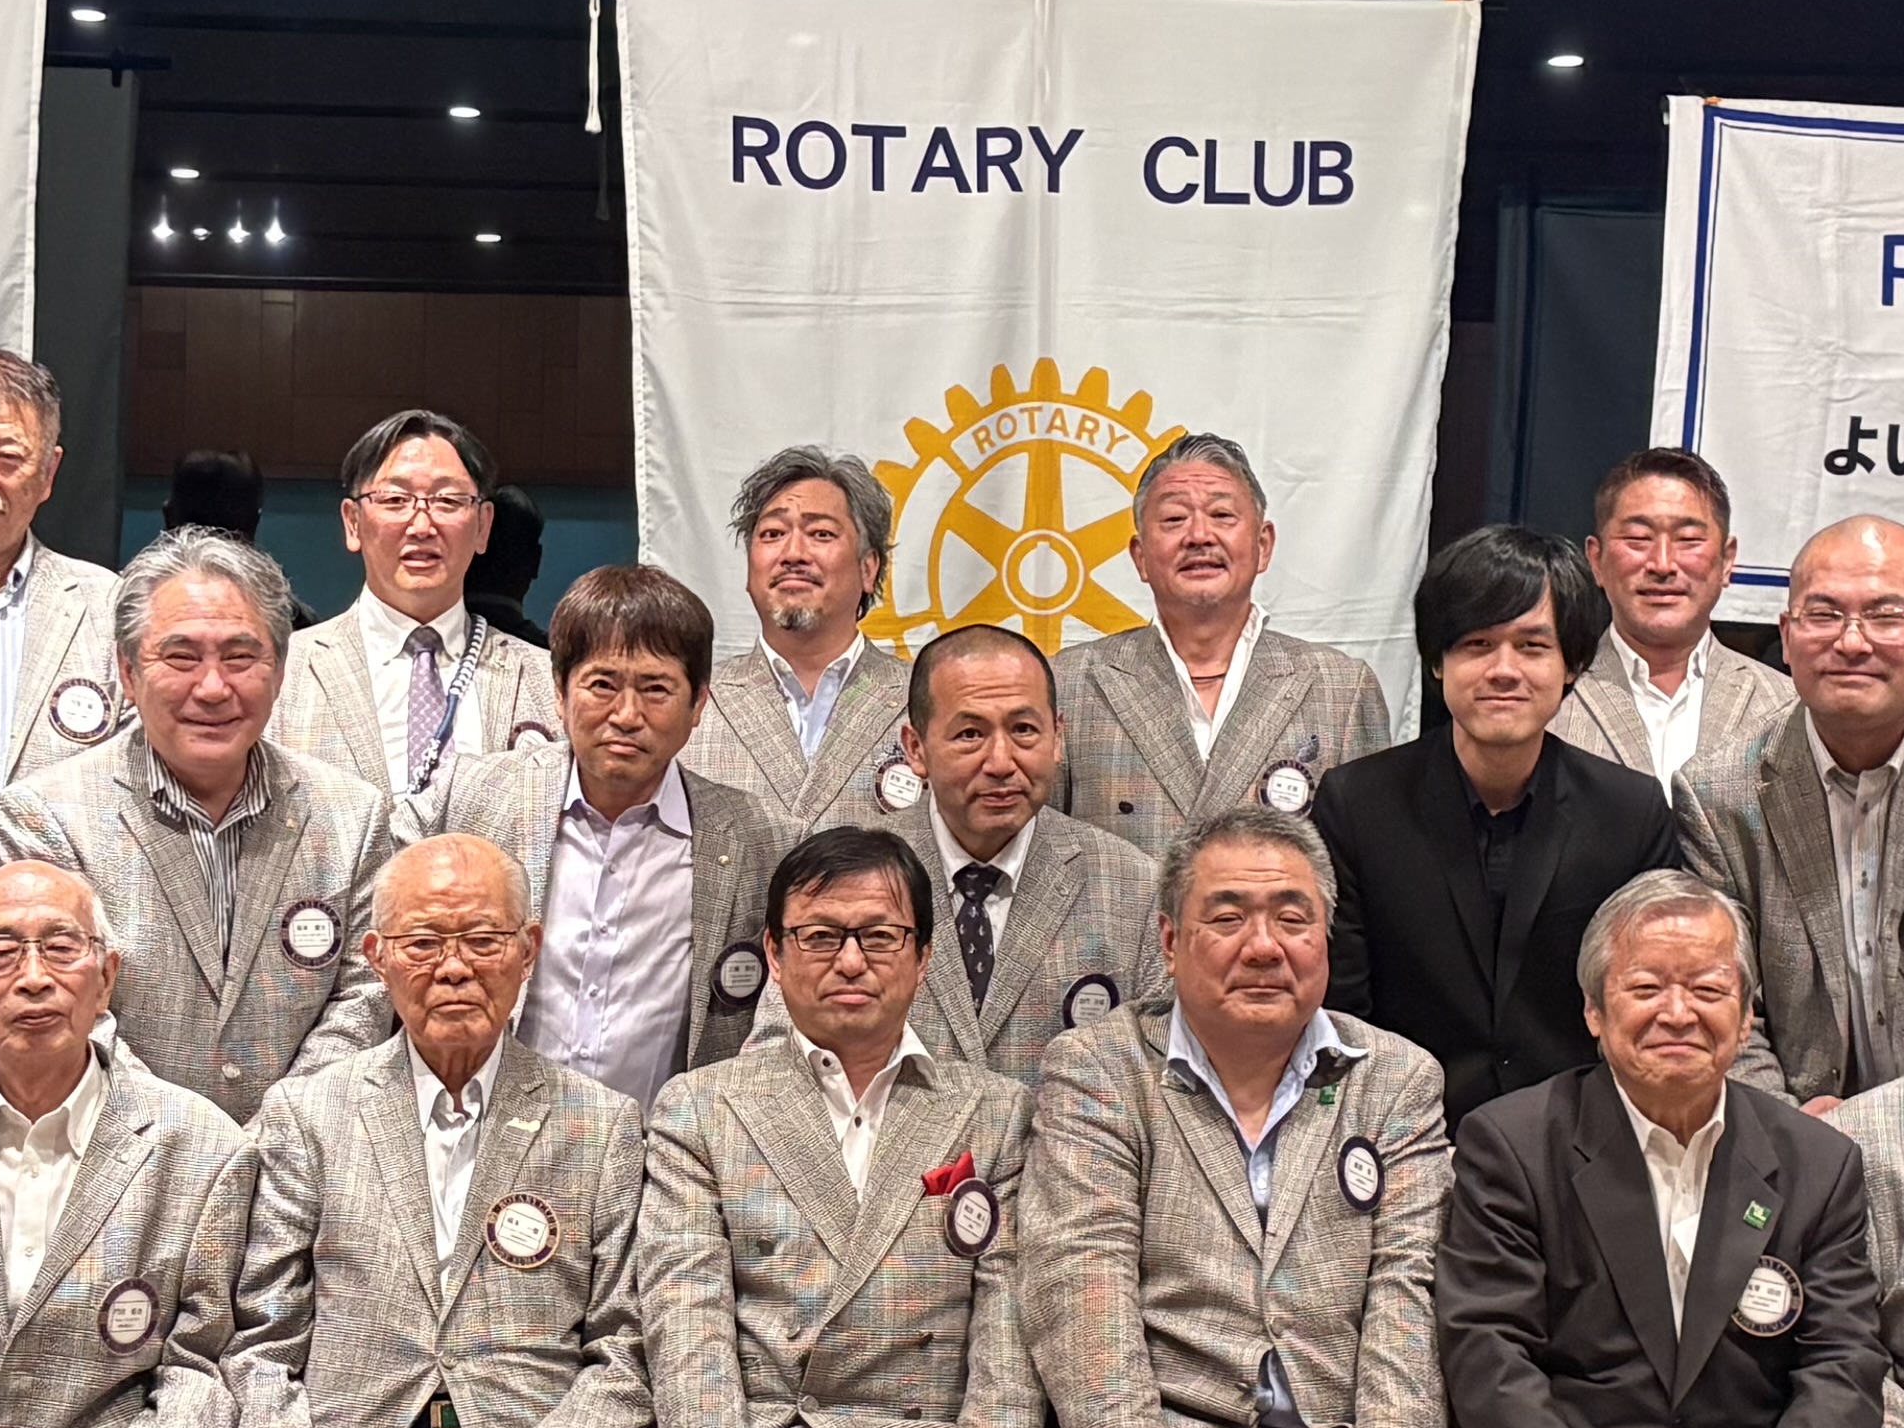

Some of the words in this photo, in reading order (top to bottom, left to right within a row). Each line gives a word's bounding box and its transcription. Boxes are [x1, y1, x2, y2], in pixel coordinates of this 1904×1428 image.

[732, 115, 1085, 193] ROTARY
[1143, 136, 1354, 206] CLUB
[971, 406, 1129, 455] ROTARY
